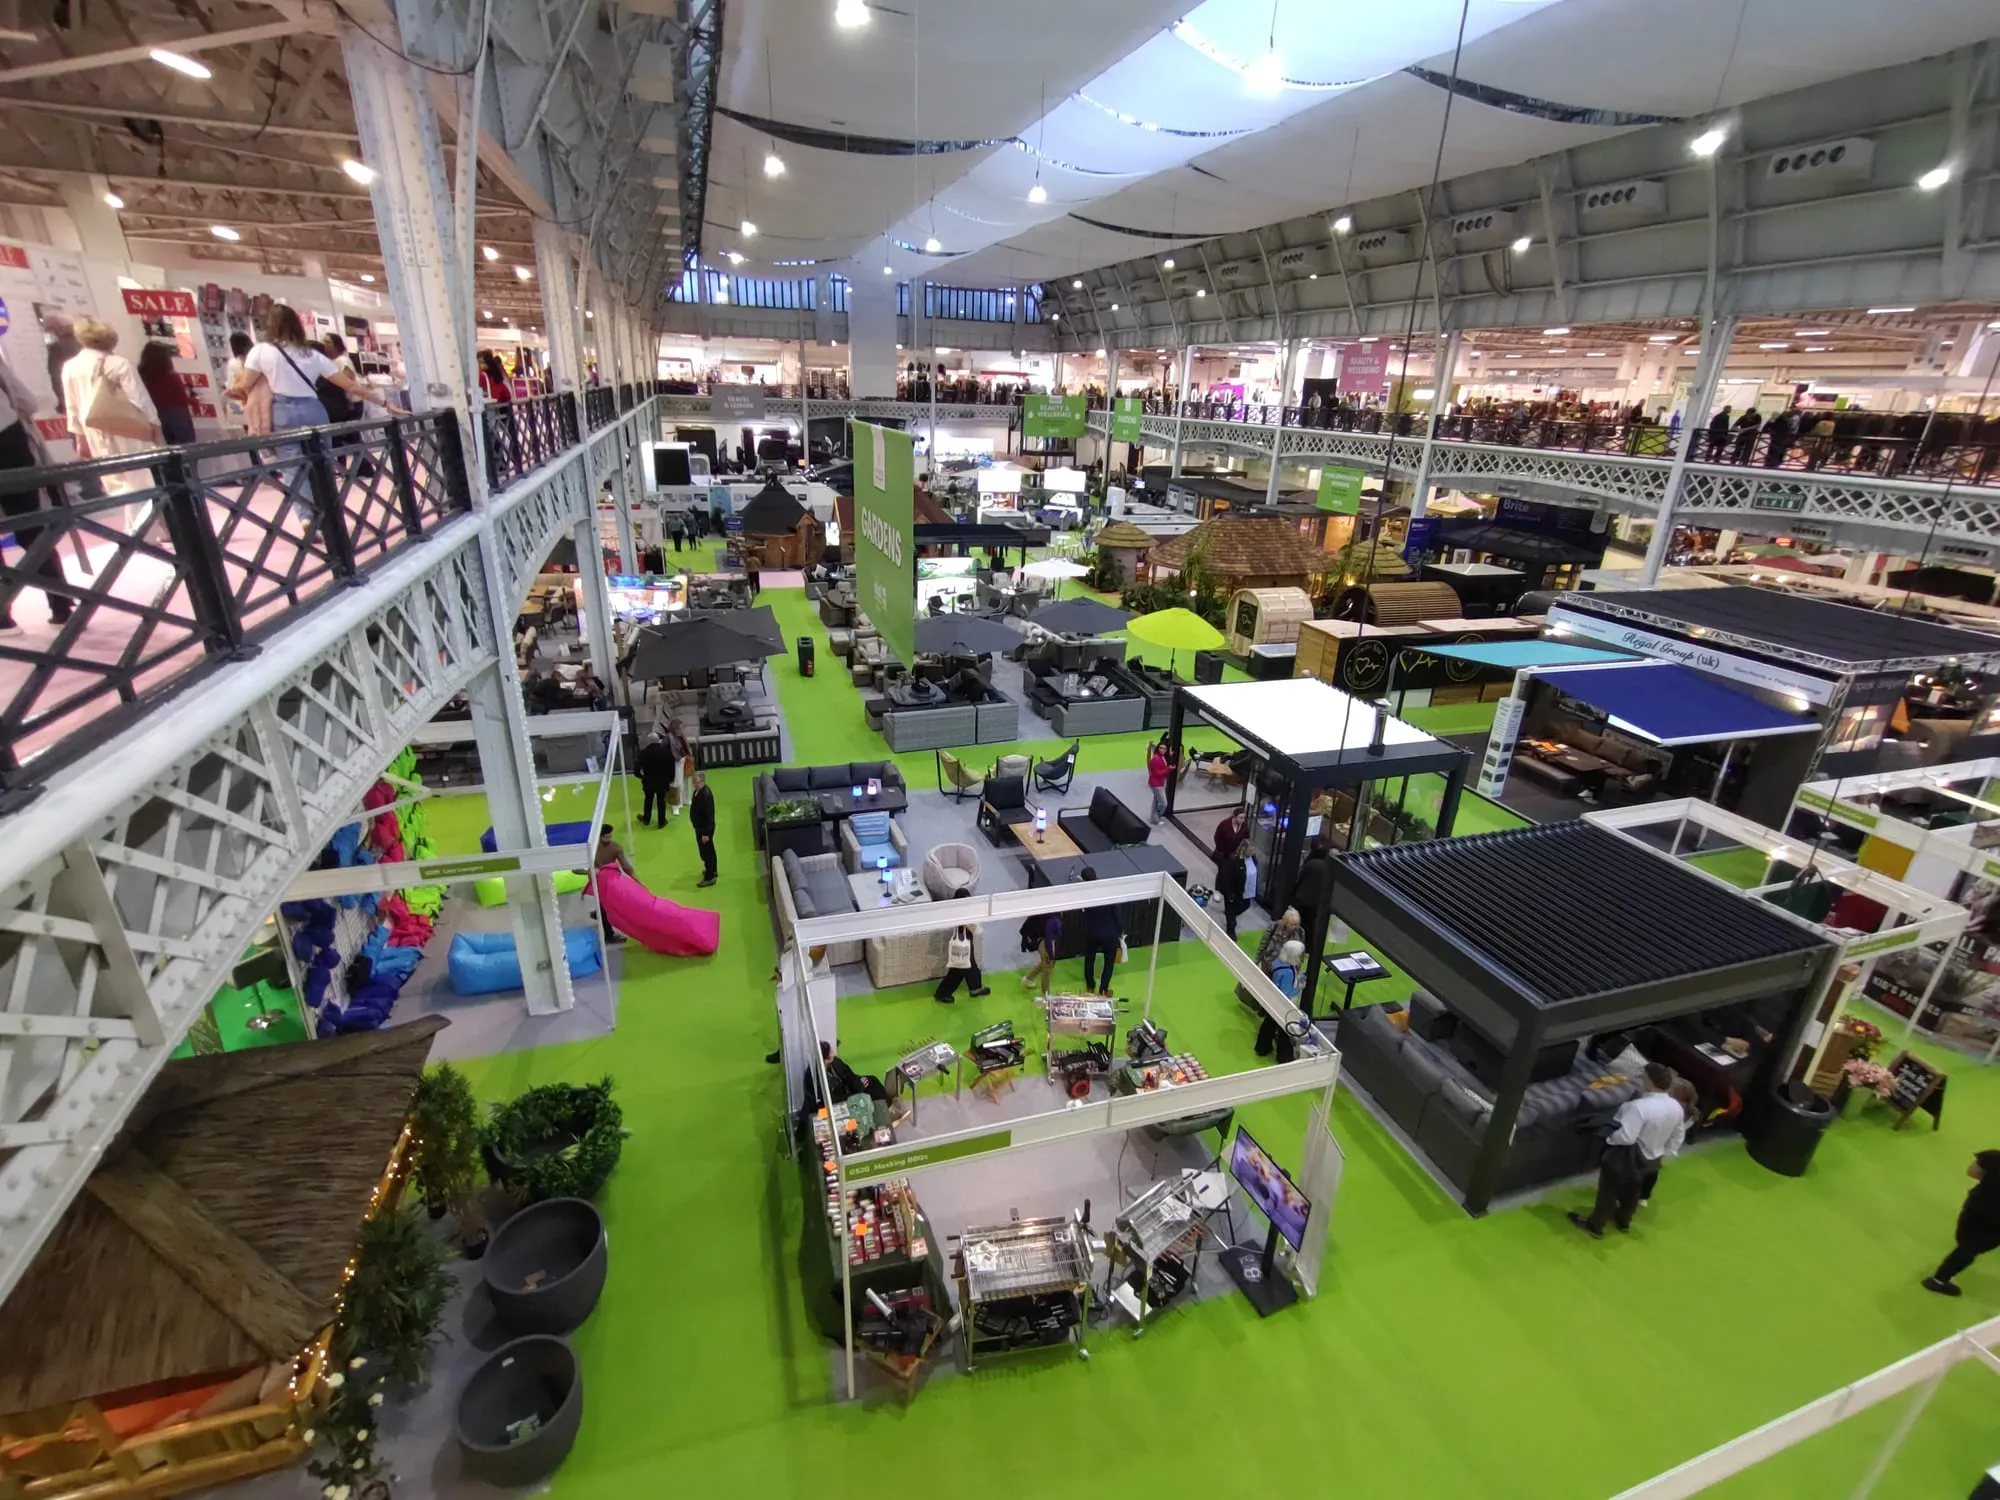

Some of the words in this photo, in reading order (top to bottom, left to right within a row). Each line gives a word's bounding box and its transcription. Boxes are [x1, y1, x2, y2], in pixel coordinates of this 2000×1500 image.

[130, 294, 189, 312] SALE
[1502, 499, 1530, 513] Brite
[861, 505, 902, 568] GARDENS
[1621, 631, 1659, 651] Regal
[1658, 643, 1697, 662] Group
[1696, 652, 1721, 670] (uk)
[1899, 988, 1942, 1016] PARES
